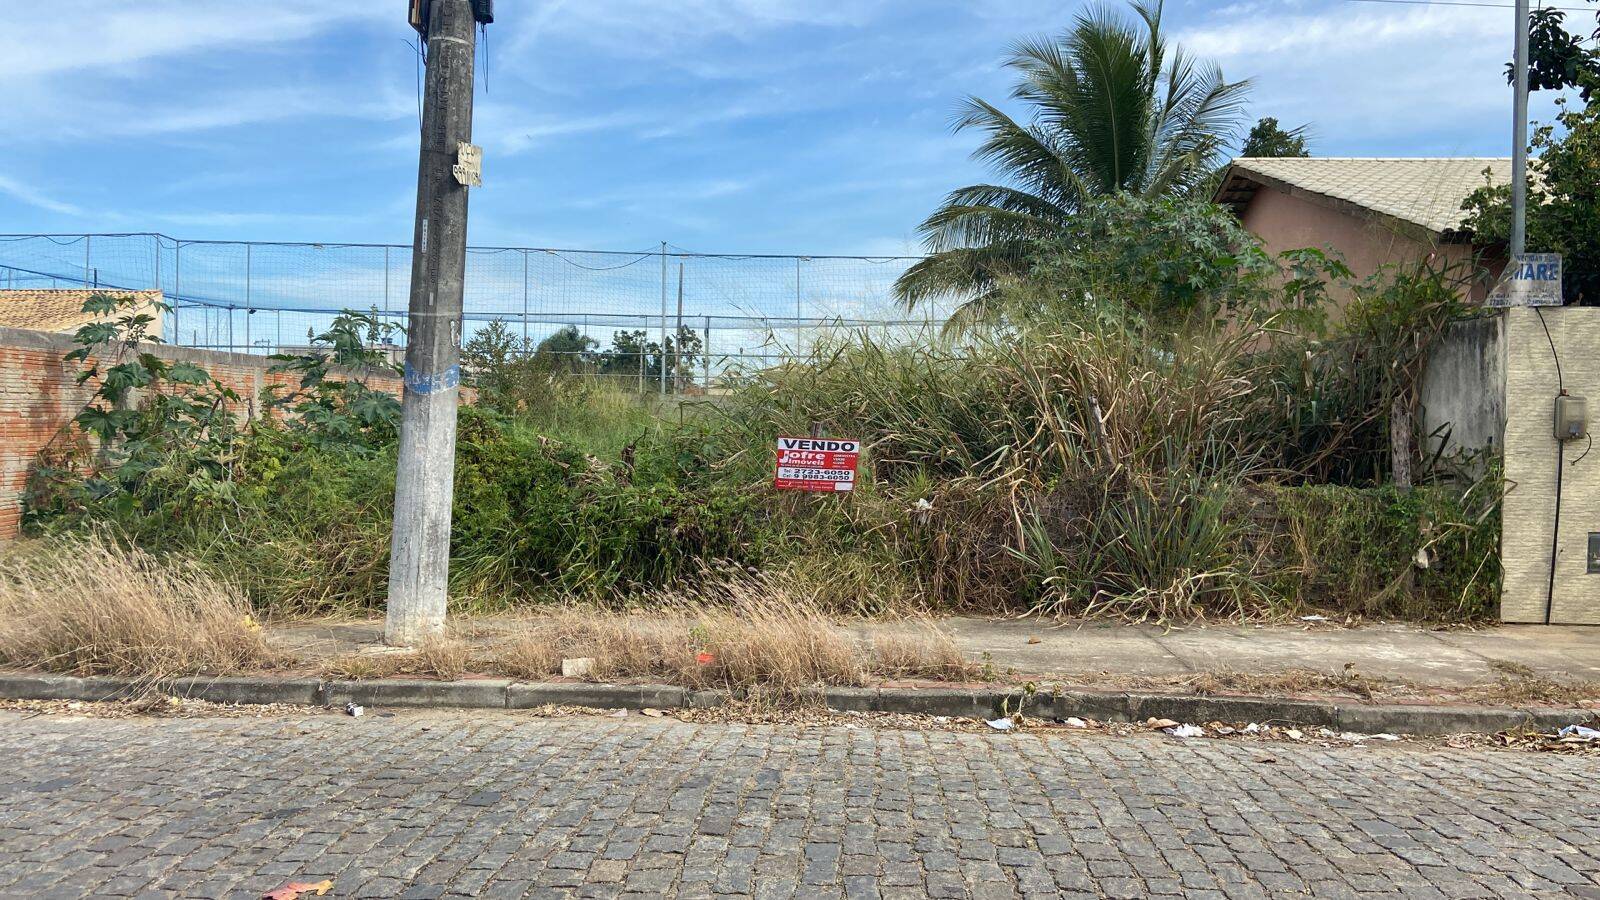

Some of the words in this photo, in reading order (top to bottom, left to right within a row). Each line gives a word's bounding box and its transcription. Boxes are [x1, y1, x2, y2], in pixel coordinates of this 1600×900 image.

[783, 439, 855, 452] VENDO
[778, 451, 826, 464] Jofre
[794, 468, 850, 476] 2723-6050
